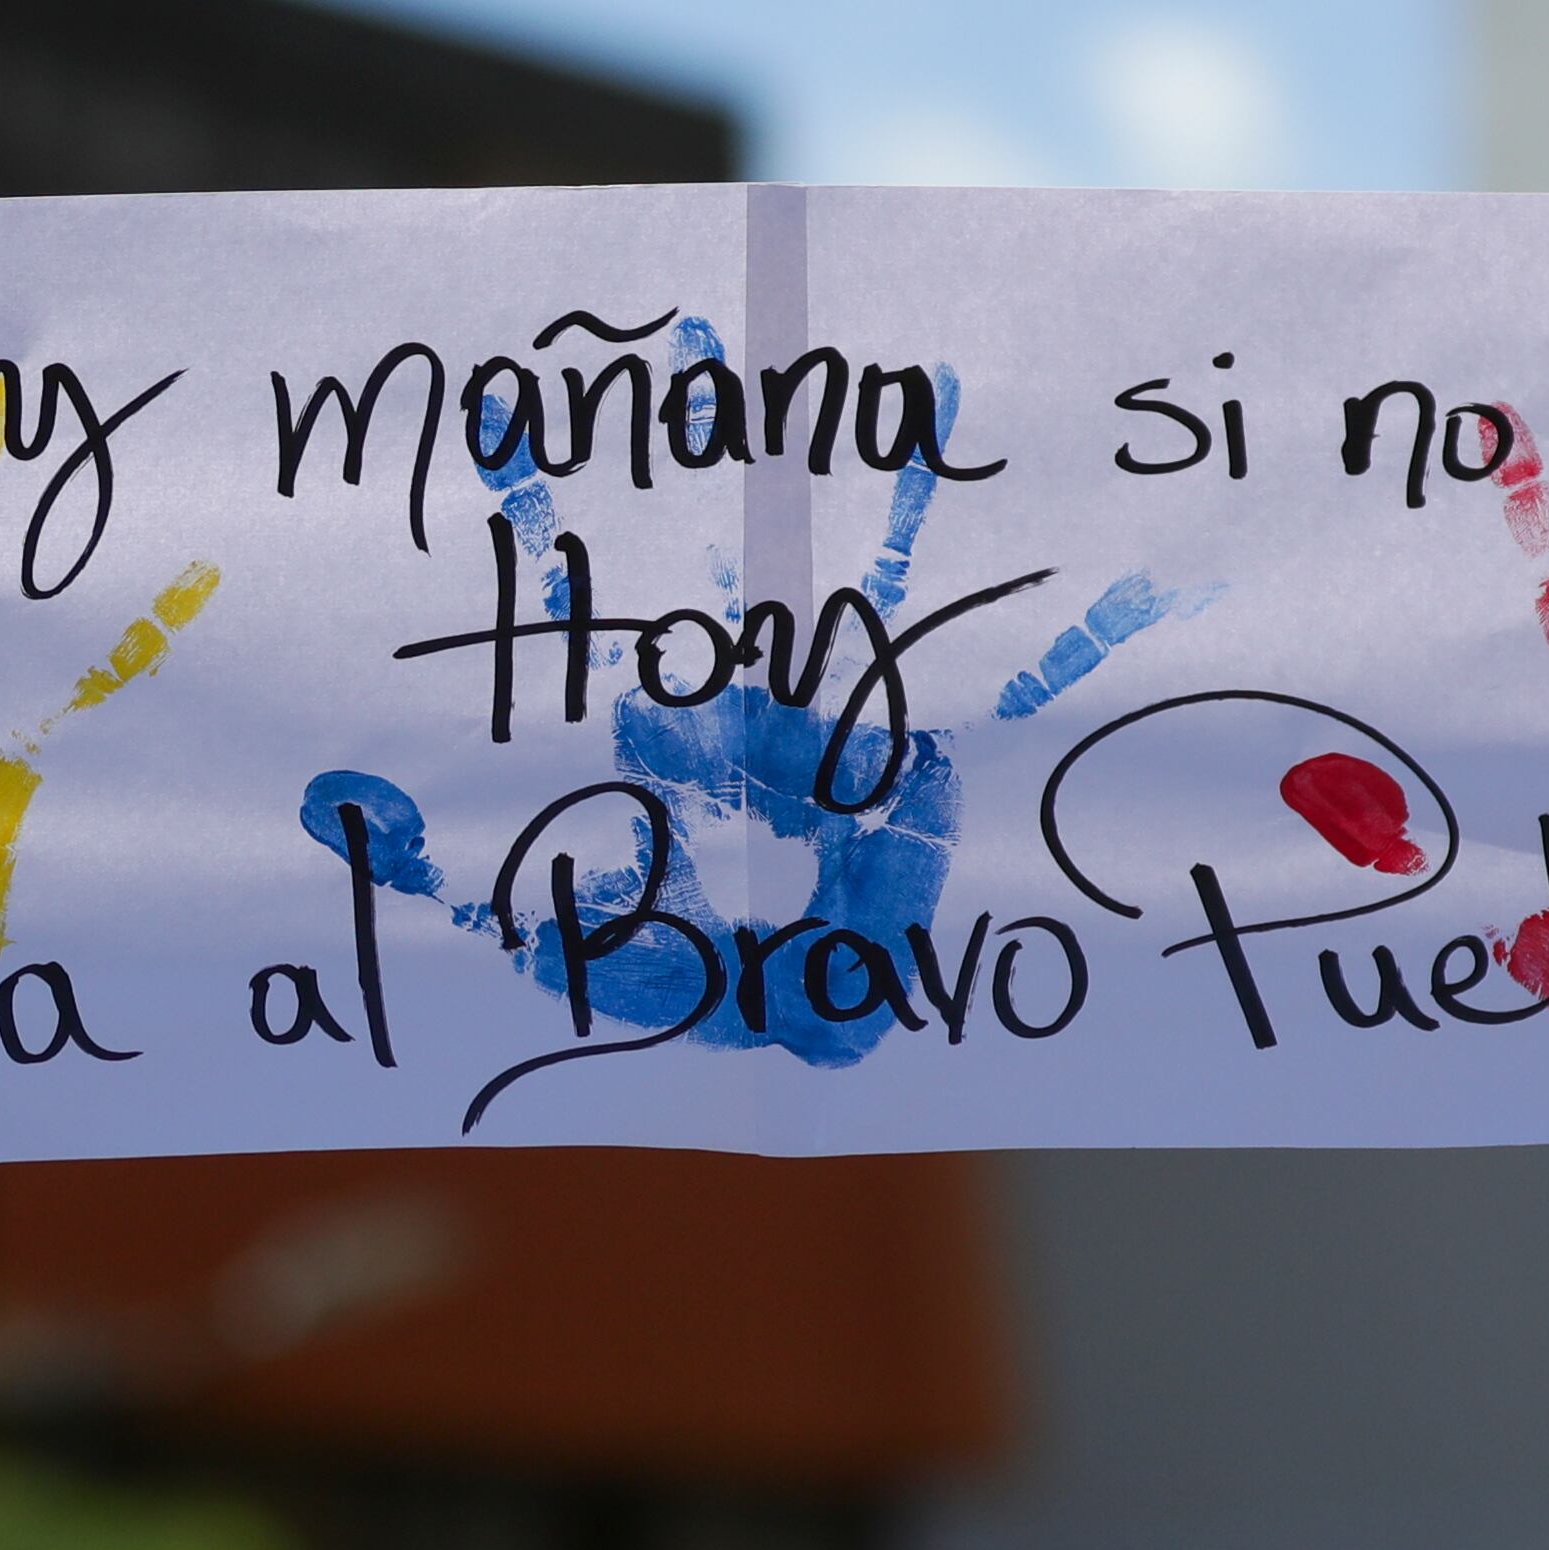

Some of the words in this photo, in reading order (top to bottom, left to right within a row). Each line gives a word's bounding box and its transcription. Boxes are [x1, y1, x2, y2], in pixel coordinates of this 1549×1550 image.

[270, 306, 1009, 553] mañana
[1114, 352, 1247, 480] si
[1340, 380, 1514, 509] no
[392, 513, 1058, 815] Hoy
[249, 802, 397, 1068] al
[462, 781, 1088, 1136] Bravo
